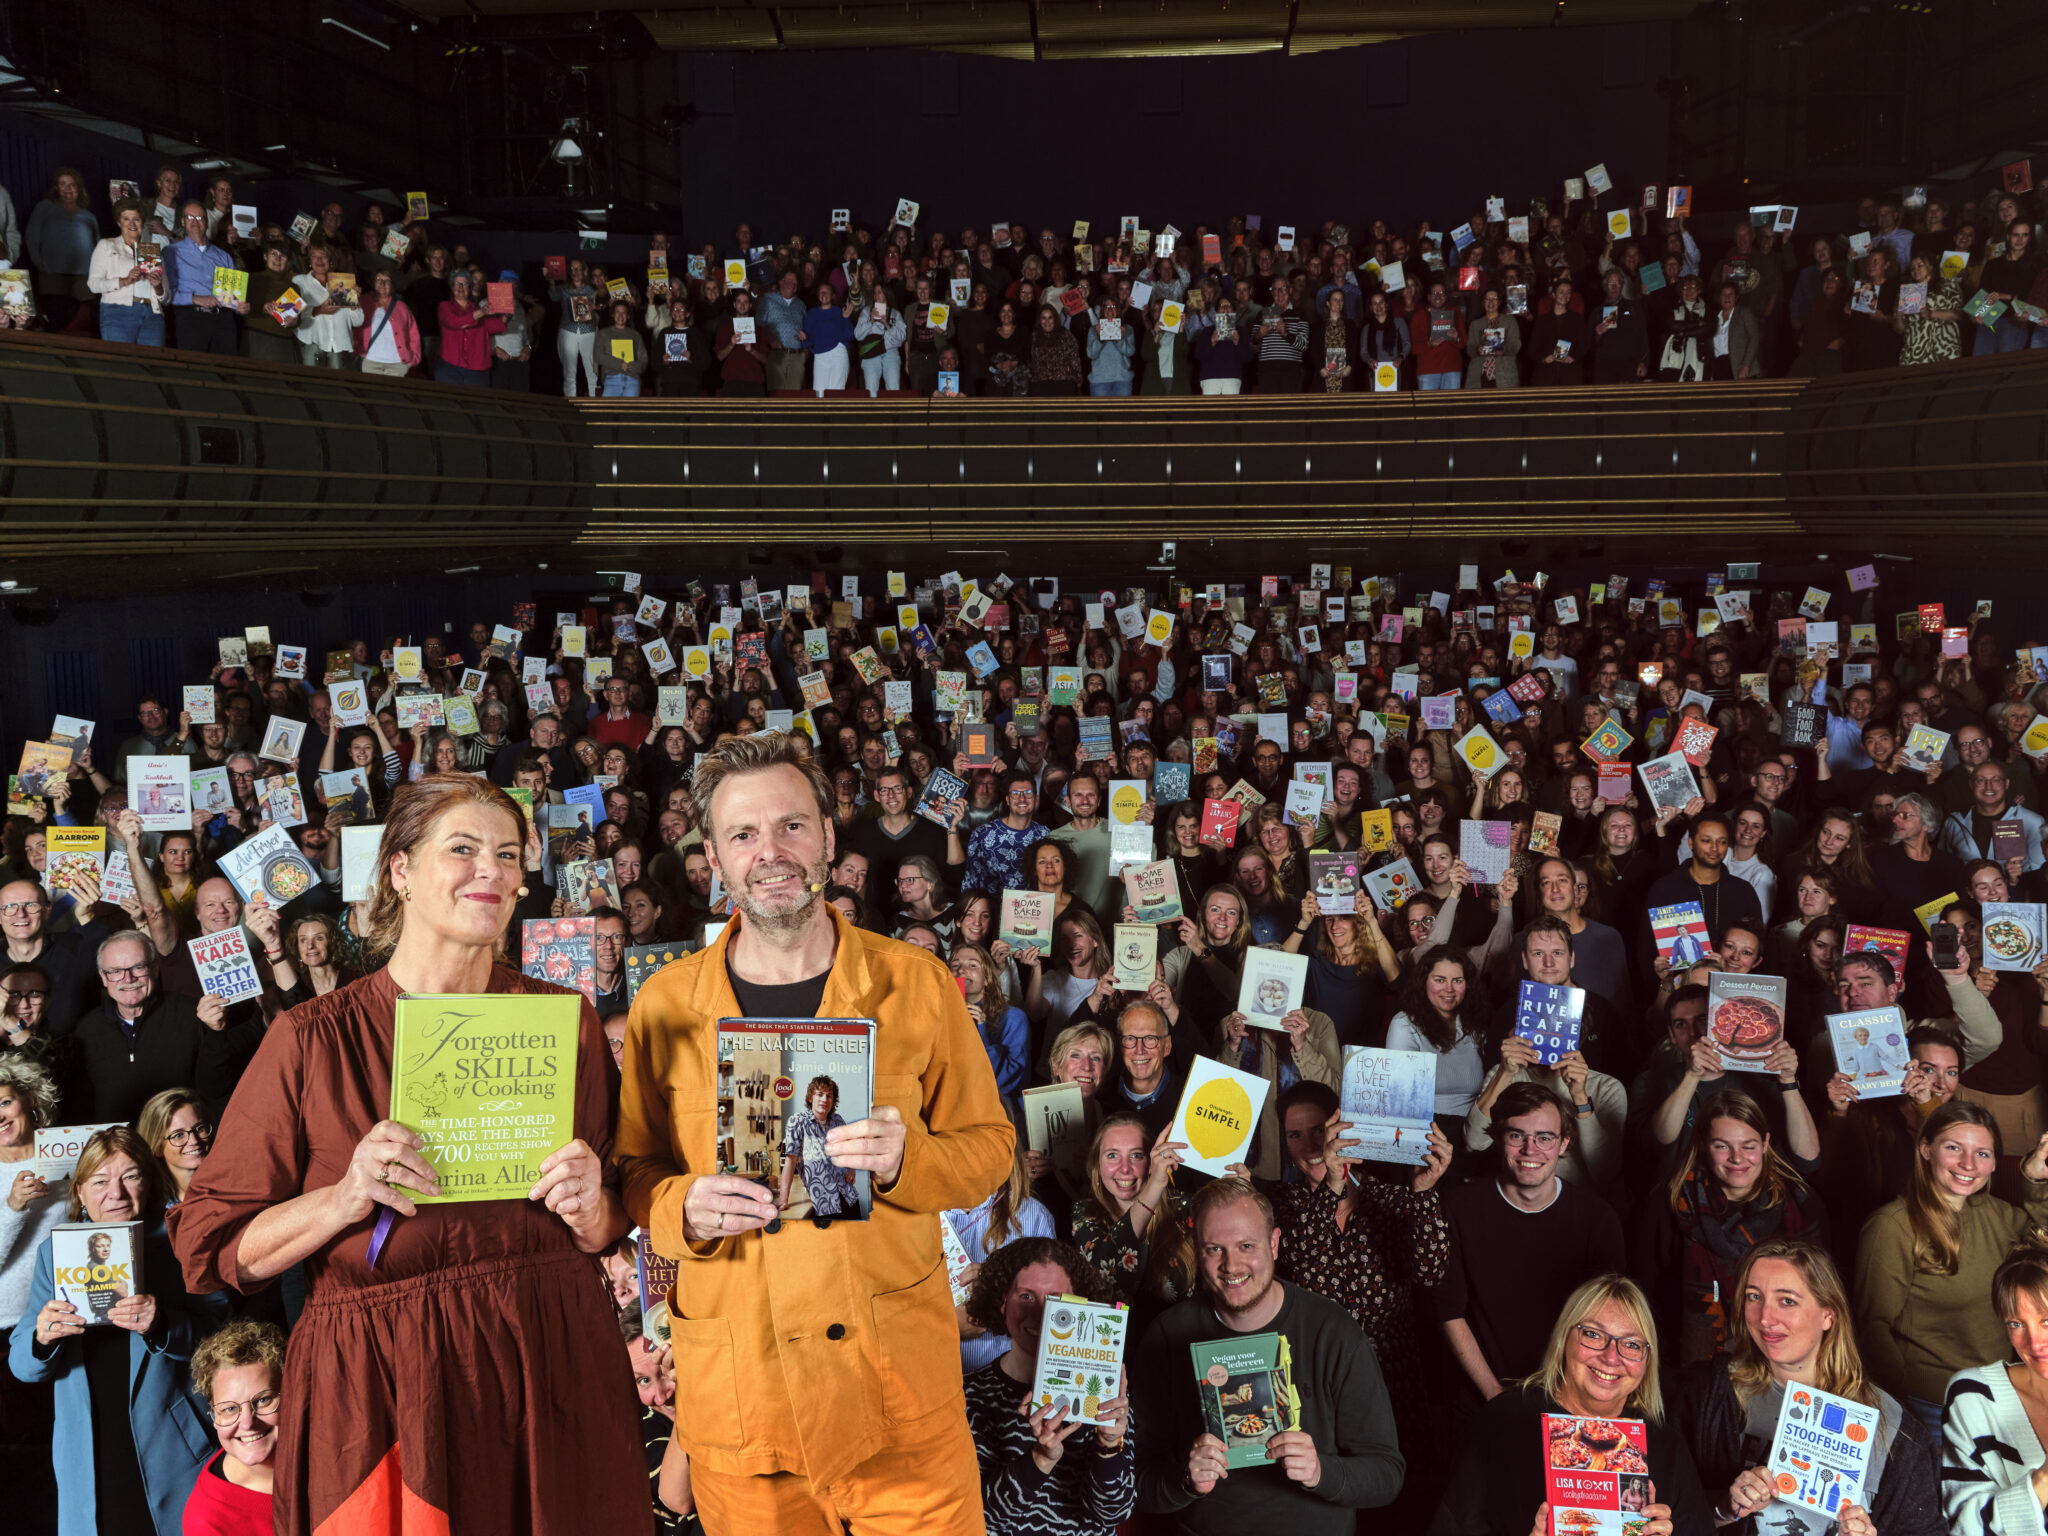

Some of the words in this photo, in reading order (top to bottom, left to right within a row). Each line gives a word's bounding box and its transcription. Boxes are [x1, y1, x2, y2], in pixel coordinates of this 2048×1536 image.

[588, 662, 610, 675] VEG
[1054, 682, 1075, 690] ASIA
[528, 689, 534, 700] 7
[1797, 707, 1815, 719] GOOD
[1796, 718, 1813, 732] FOOD
[1794, 730, 1812, 743] BOOK
[1911, 729, 1944, 754] VEG
[1471, 744, 1489, 760] SIMPEL
[1593, 740, 1611, 756] INDIA
[191, 779, 201, 791] 5
[935, 776, 962, 793] KOOK
[1660, 774, 1674, 784] het
[931, 783, 959, 801] BOEK
[1238, 783, 1256, 799] JAMIE
[1653, 783, 1669, 794] wild
[1208, 808, 1232, 819] JAPANS
[1136, 868, 1163, 881] HOME
[568, 873, 578, 895] BAKED
[1138, 877, 1164, 889] BAKED
[1014, 899, 1041, 908] HOME
[1014, 907, 1041, 917] BAKED
[2002, 911, 2046, 922] BEANS
[193, 931, 240, 951] HOLLANDSE
[1850, 933, 1864, 942] Mijn
[1865, 935, 1906, 945] koekjesboek
[195, 939, 245, 966] KAAS
[528, 944, 592, 963] HOME
[204, 966, 252, 991] BETTY
[530, 963, 593, 981] MADE
[1719, 980, 1749, 989] Dessert
[1750, 982, 1777, 992] Person
[1521, 1017, 1579, 1035] CAFE
[1839, 1015, 1894, 1030] CLASSIC
[402, 1011, 557, 1076] Forgotten
[721, 1037, 759, 1052] THE
[761, 1037, 817, 1053] NAKED
[824, 1038, 868, 1055] CHEF
[454, 1055, 557, 1080] SKILLS
[789, 1061, 824, 1073] Jamie
[828, 1062, 863, 1075] Oliver
[1356, 1056, 1391, 1074] HOME
[776, 1082, 793, 1093] food
[1355, 1071, 1392, 1089] SWEET
[1852, 1081, 1877, 1092] MARY
[454, 1082, 466, 1098] of
[468, 1080, 555, 1100] Cooking
[1354, 1088, 1388, 1106] HOME
[1208, 1103, 1234, 1117] Ottolenghi
[1353, 1104, 1388, 1119] XMAS
[420, 1119, 437, 1129] THE
[439, 1114, 556, 1129] TIME-HONORED
[1195, 1106, 1241, 1131] SIMPEL
[448, 1129, 478, 1143] ARE
[481, 1128, 513, 1142] THE
[1041, 1105, 1072, 1157] joy
[433, 1143, 471, 1164] 700
[474, 1142, 522, 1154] RECIPES
[525, 1140, 552, 1151] SHOW
[474, 1152, 499, 1162] YOU
[501, 1151, 525, 1161] WHY
[432, 1169, 487, 1187] arina
[644, 1254, 676, 1268] VAN
[55, 1261, 132, 1286] KOOK
[646, 1268, 677, 1282] HET
[71, 1286, 87, 1294] met
[87, 1283, 116, 1293] JAMIE
[1211, 1353, 1235, 1365] Vegan
[1236, 1350, 1256, 1361] voor
[1556, 1477, 1573, 1489] LISA
